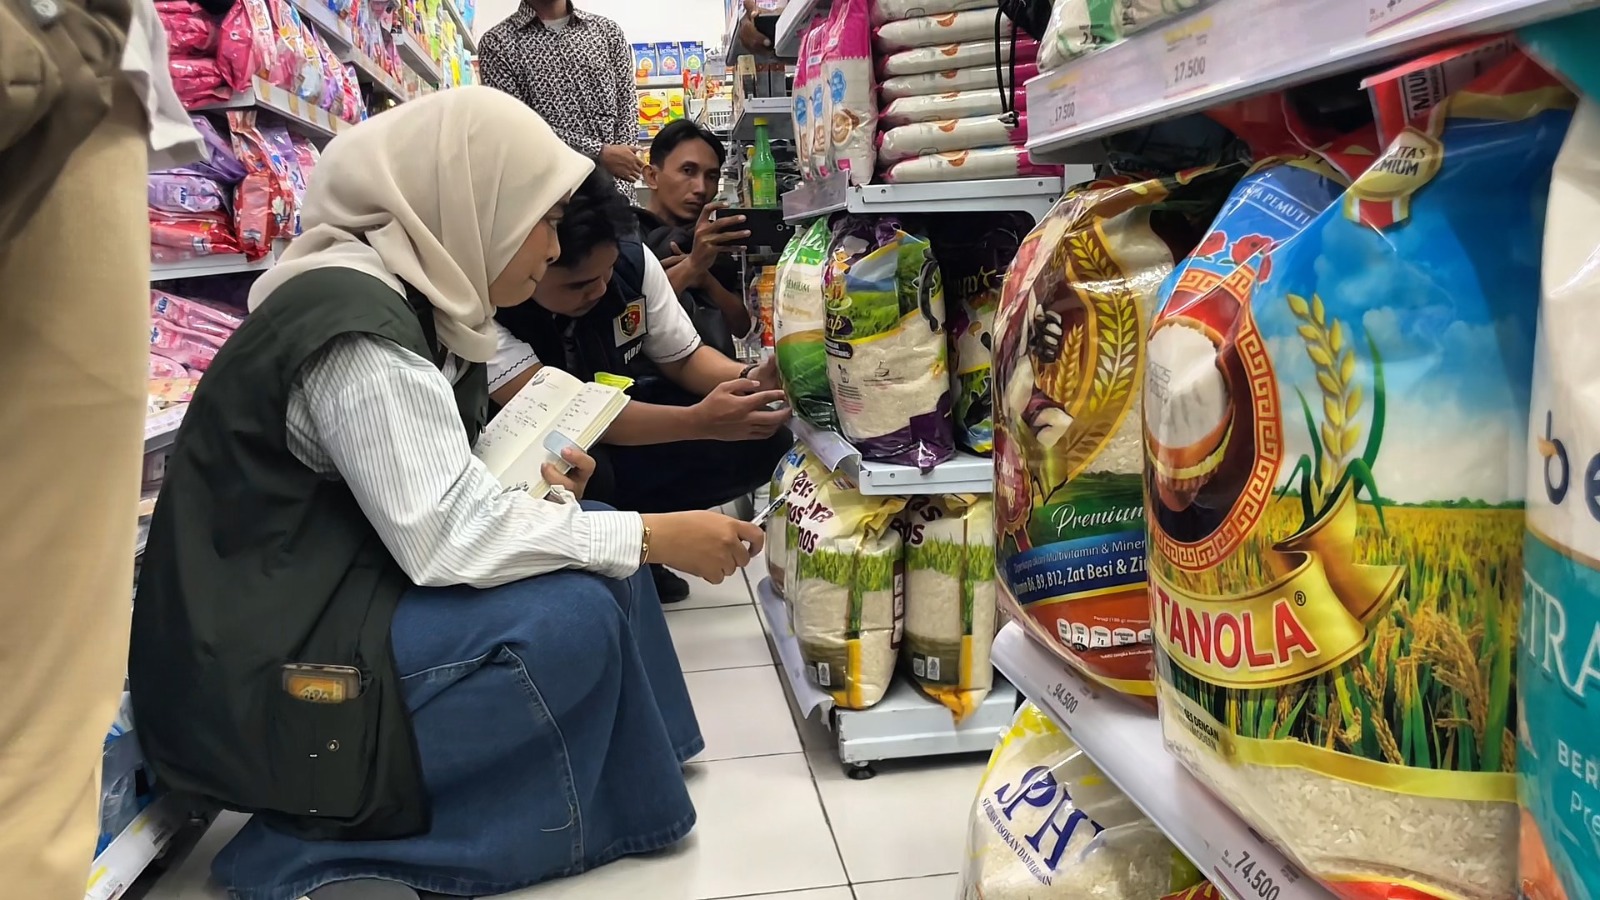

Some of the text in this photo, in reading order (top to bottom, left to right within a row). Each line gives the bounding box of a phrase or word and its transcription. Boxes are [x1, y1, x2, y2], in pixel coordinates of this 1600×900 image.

[1174, 57, 1206, 83] 17.500
[1067, 567, 1085, 583] Zat
[1087, 561, 1113, 580] Besi
[1116, 559, 1127, 575] &
[1154, 585, 1319, 669] TANOLA
[1053, 683, 1078, 714] 94.500
[1235, 851, 1280, 900] 74.500
